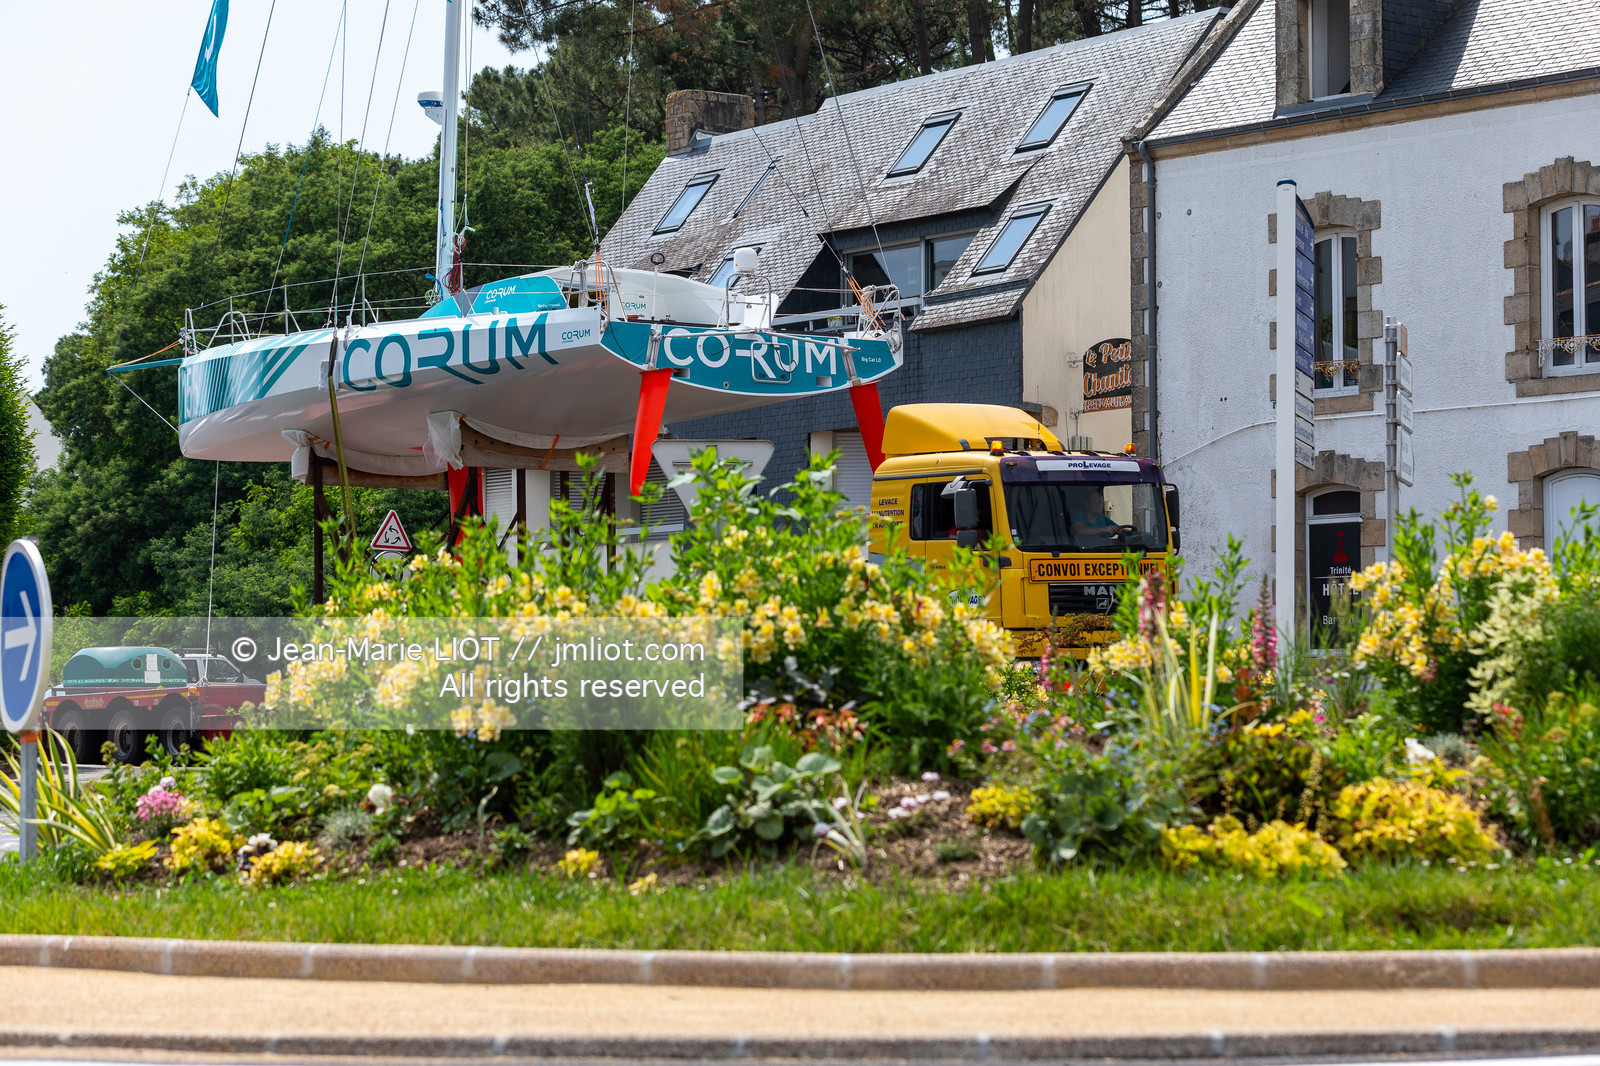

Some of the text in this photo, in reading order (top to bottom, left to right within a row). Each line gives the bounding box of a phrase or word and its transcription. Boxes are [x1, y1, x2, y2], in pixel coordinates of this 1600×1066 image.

[486, 285, 516, 300] CORUM
[561, 329, 591, 340] CORUM
[342, 312, 559, 392] CORUM
[662, 328, 837, 379] CORUM
[878, 498, 898, 506] LEVAGE
[1037, 563, 1080, 577] CONVOI
[1330, 565, 1352, 575] Trinité
[1322, 581, 1359, 597] HÔTL
[1322, 615, 1337, 625] Bar
